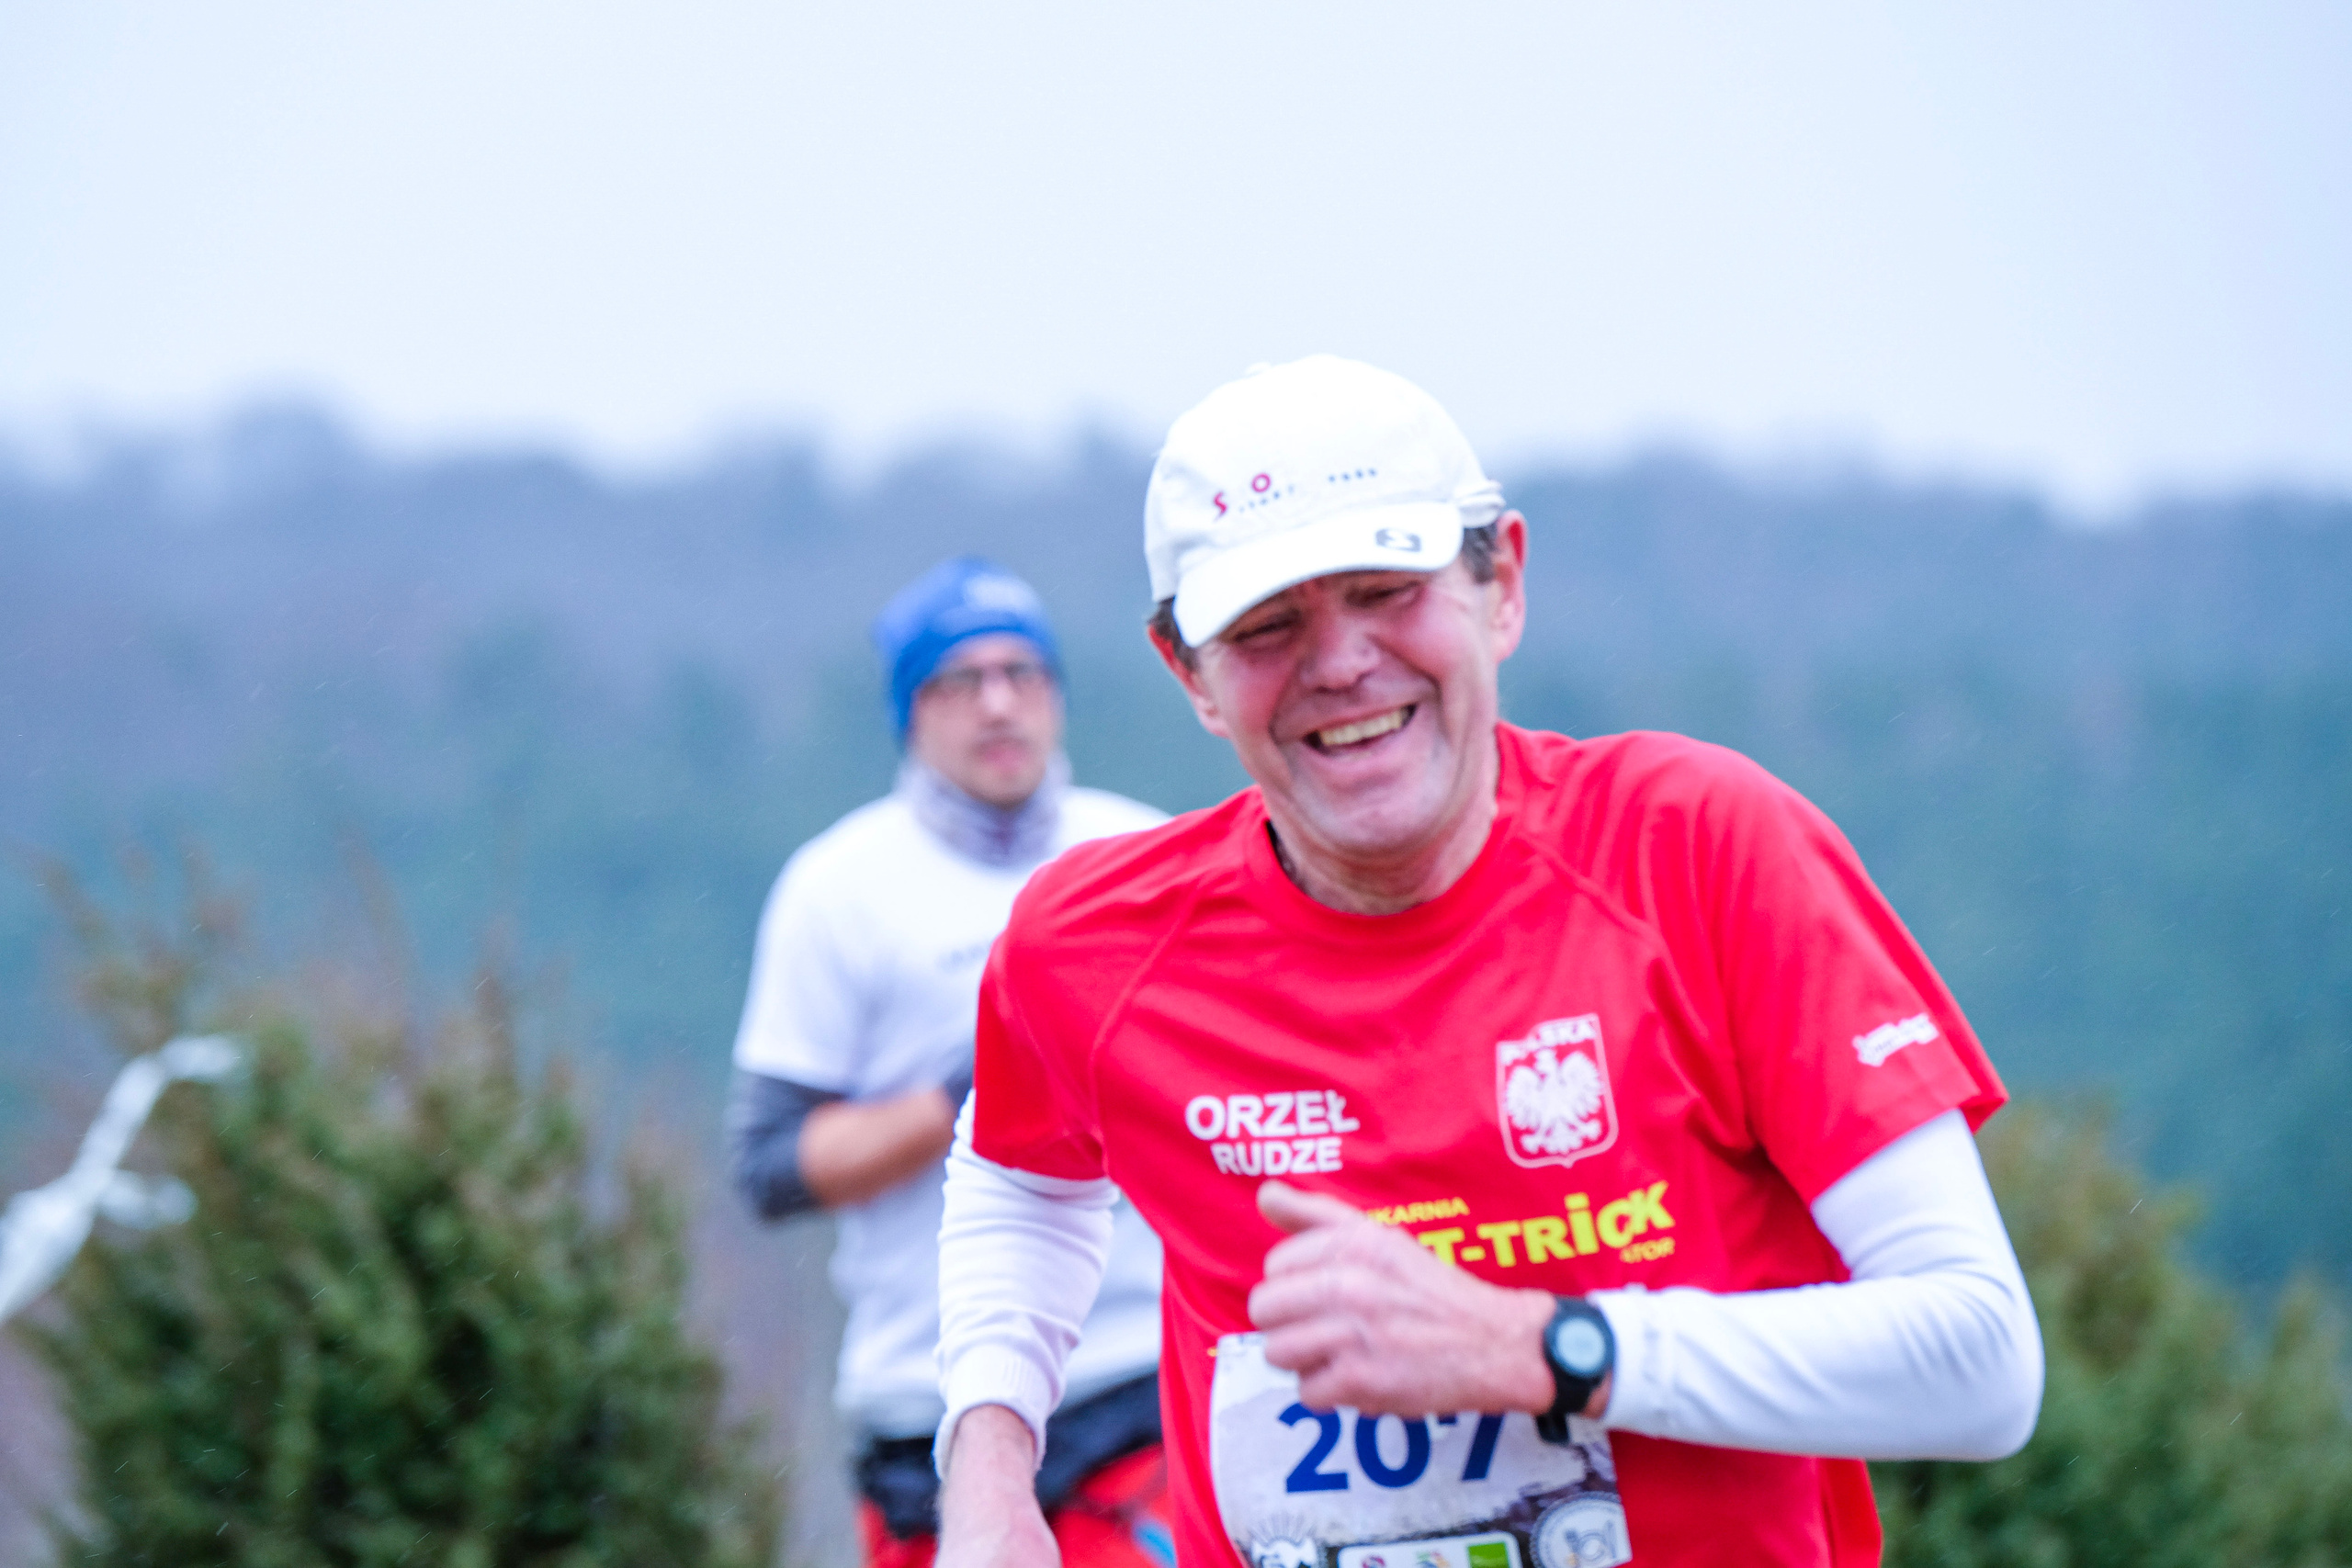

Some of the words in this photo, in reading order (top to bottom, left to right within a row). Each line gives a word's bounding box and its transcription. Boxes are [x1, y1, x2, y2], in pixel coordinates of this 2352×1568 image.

[1184, 1089, 1361, 1141] ORZEŁ
[1210, 1136, 1343, 1177] RUDZE
[1278, 1402, 1506, 1494] 207
